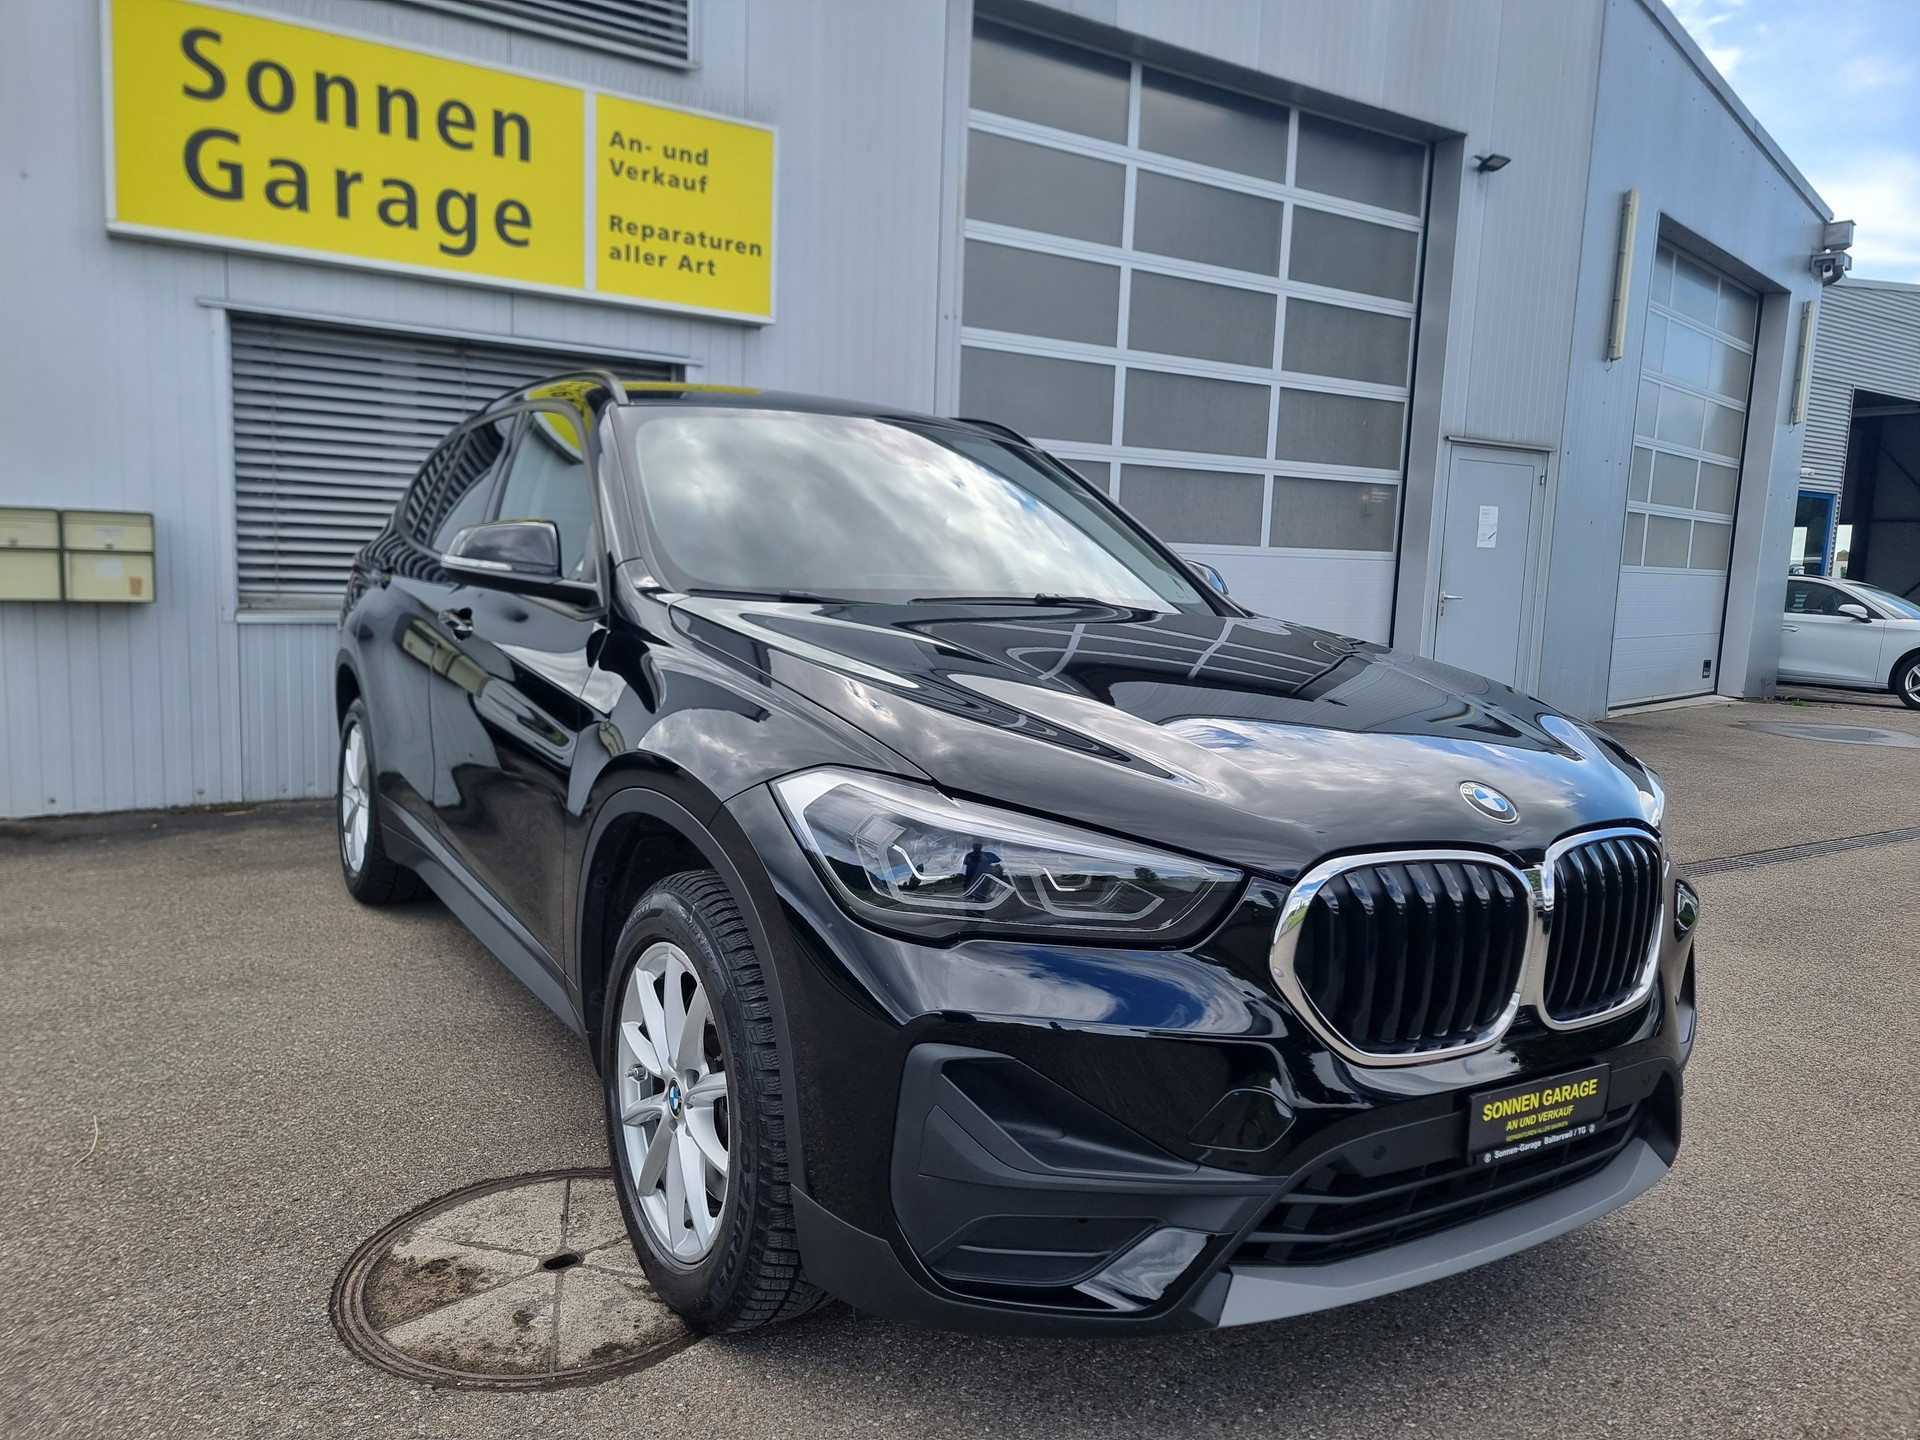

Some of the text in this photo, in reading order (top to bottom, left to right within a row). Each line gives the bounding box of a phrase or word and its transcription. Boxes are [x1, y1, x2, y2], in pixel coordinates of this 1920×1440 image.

[180, 27, 531, 163] Sonnen
[609, 131, 709, 167] An- und
[182, 127, 533, 257] Garage
[609, 159, 708, 194] Verkauf
[610, 214, 763, 258] Reparaturen
[609, 244, 717, 277] aller Art
[1482, 1078, 1599, 1122] SONNEN GARAGE
[1505, 1105, 1575, 1132] AN UND VERKAUF
[1494, 1140, 1541, 1159] Sonnen-Garage
[1577, 1126, 1587, 1135] TG
